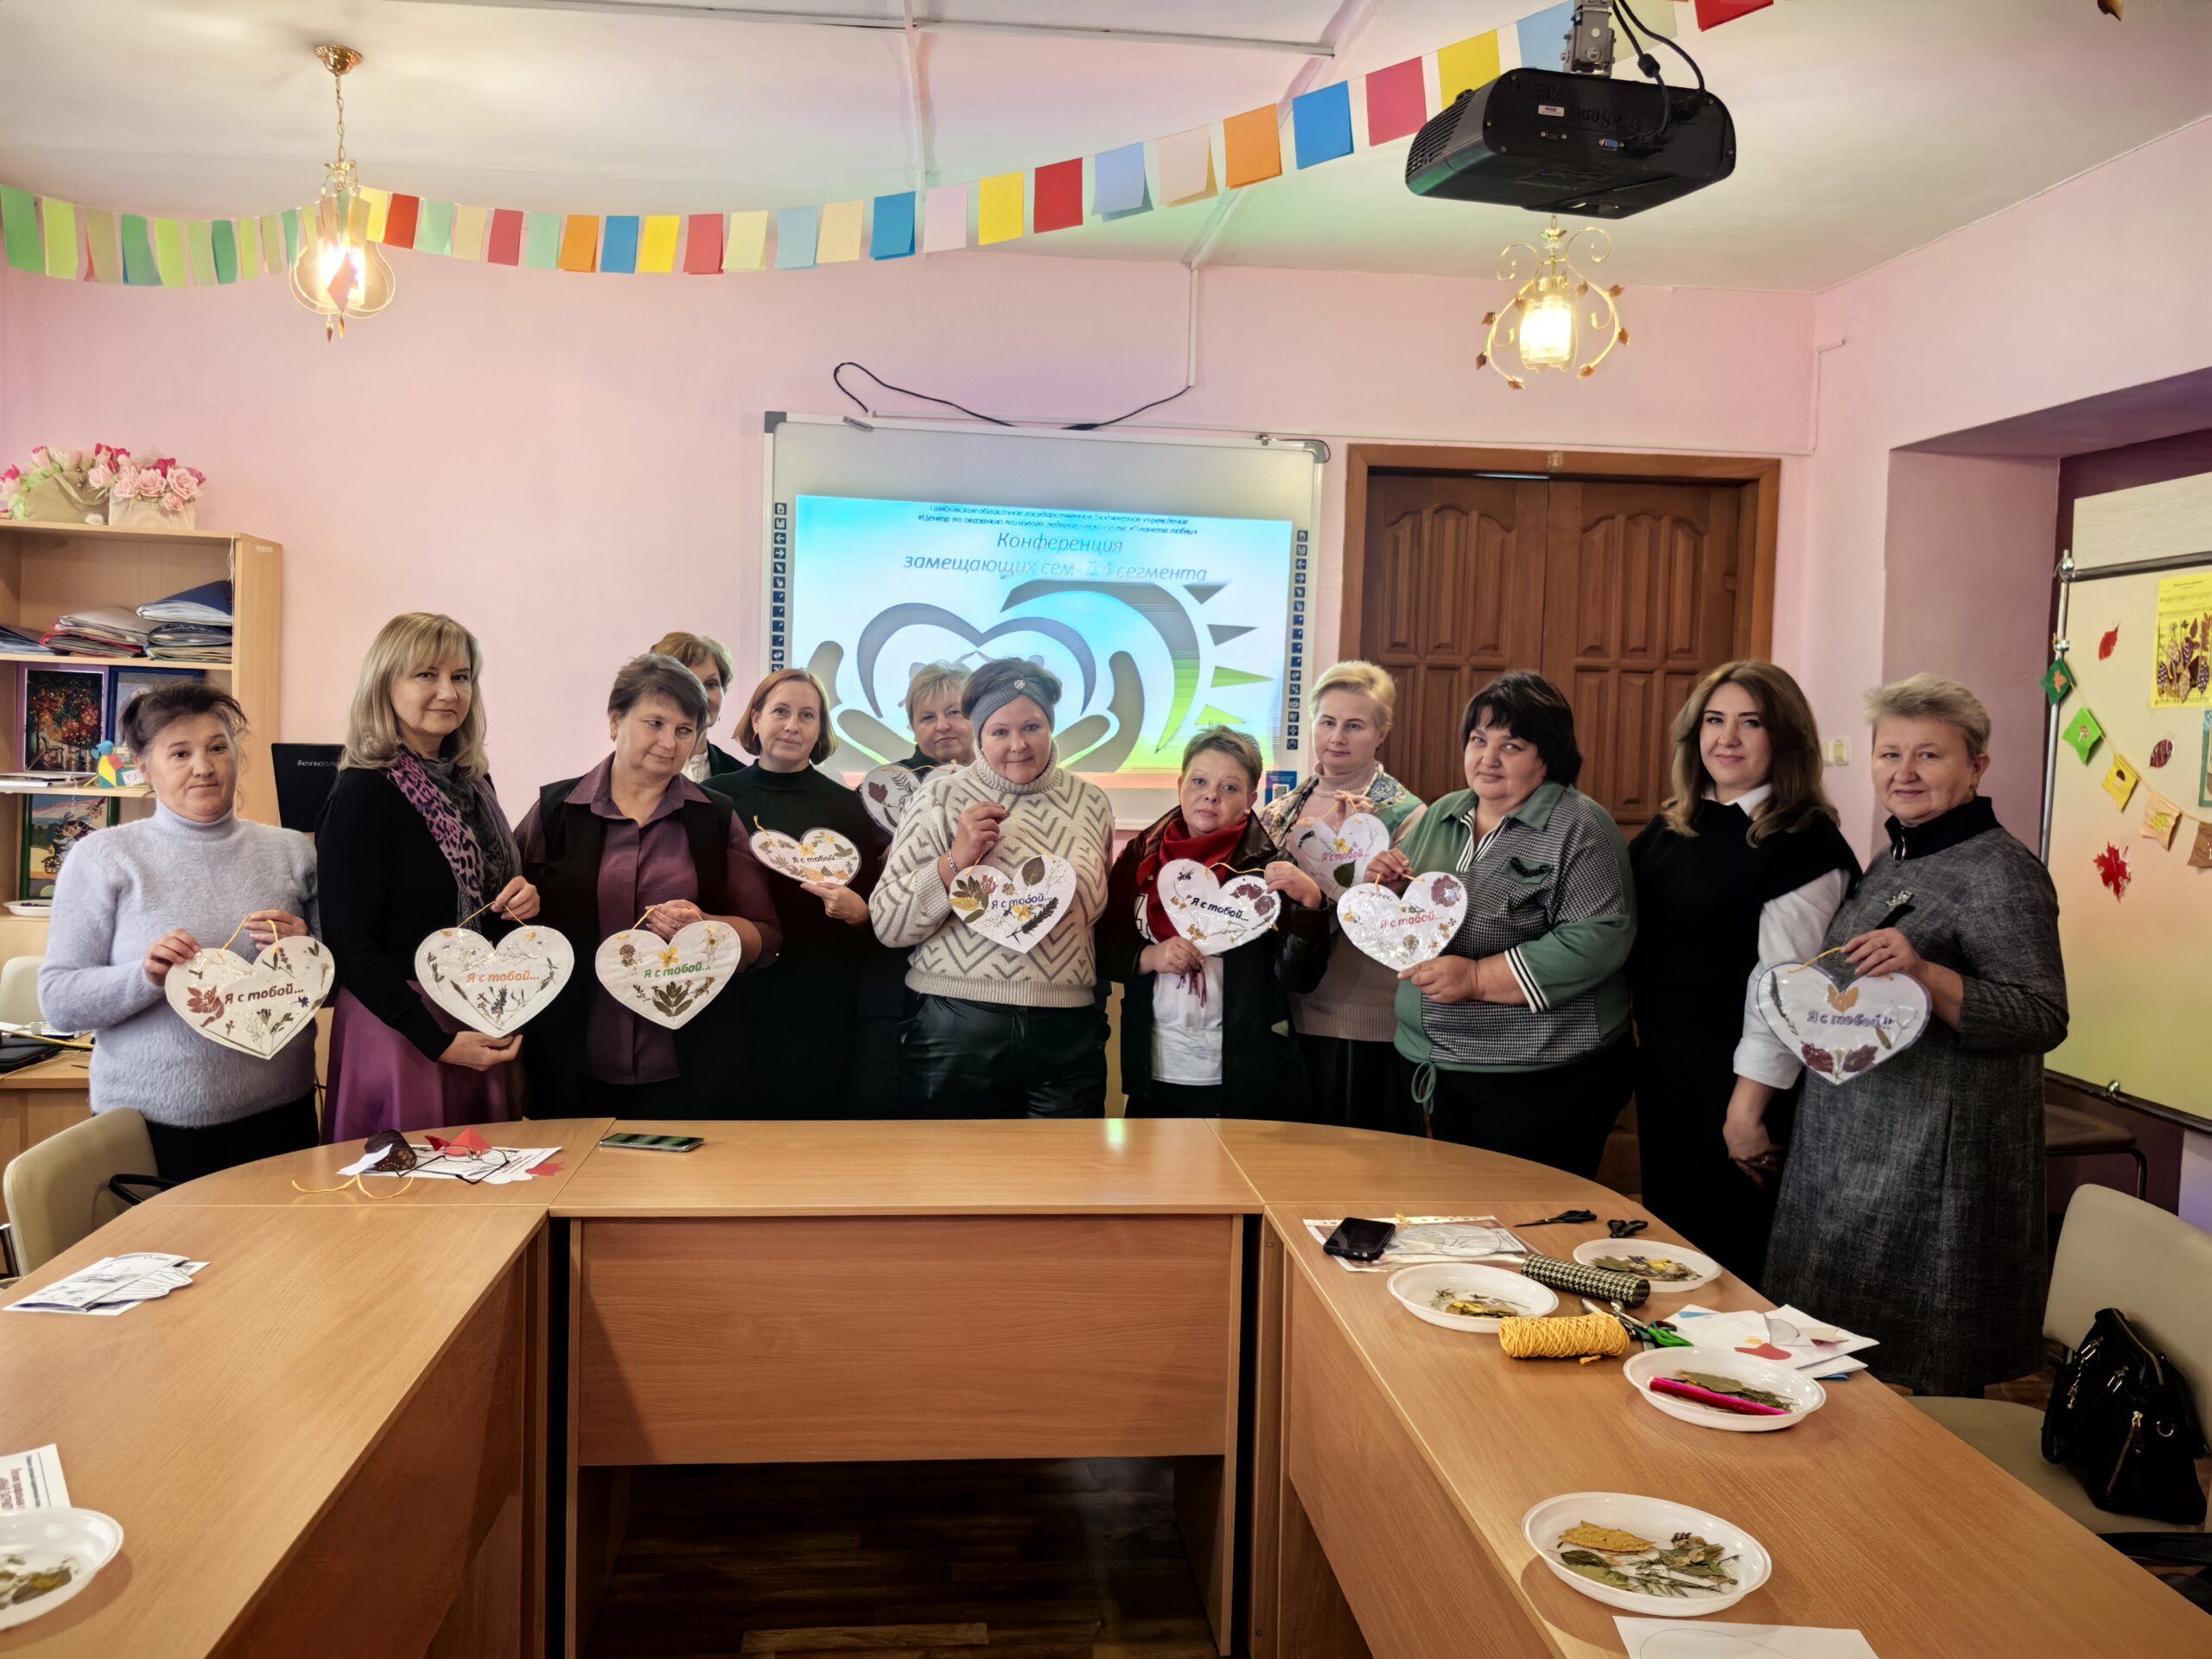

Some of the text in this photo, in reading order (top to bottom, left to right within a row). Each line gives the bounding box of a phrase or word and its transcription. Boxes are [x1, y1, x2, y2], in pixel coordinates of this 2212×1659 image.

[997, 532, 1123, 555] Конференция
[902, 555, 1036, 575] замещающих
[1116, 565, 1207, 583] сегмента
[1321, 851, 1328, 862] Я
[991, 899, 999, 910] Я
[1191, 897, 1200, 906] Я
[1200, 900, 1208, 909] с
[1380, 919, 1388, 929] Я
[467, 973, 476, 983] Я
[478, 974, 486, 982] с
[644, 969, 652, 978] Я
[225, 993, 233, 1005] Я
[238, 994, 245, 1002] с
[1807, 1010, 1819, 1024] Я
[1820, 1014, 1828, 1025] с
